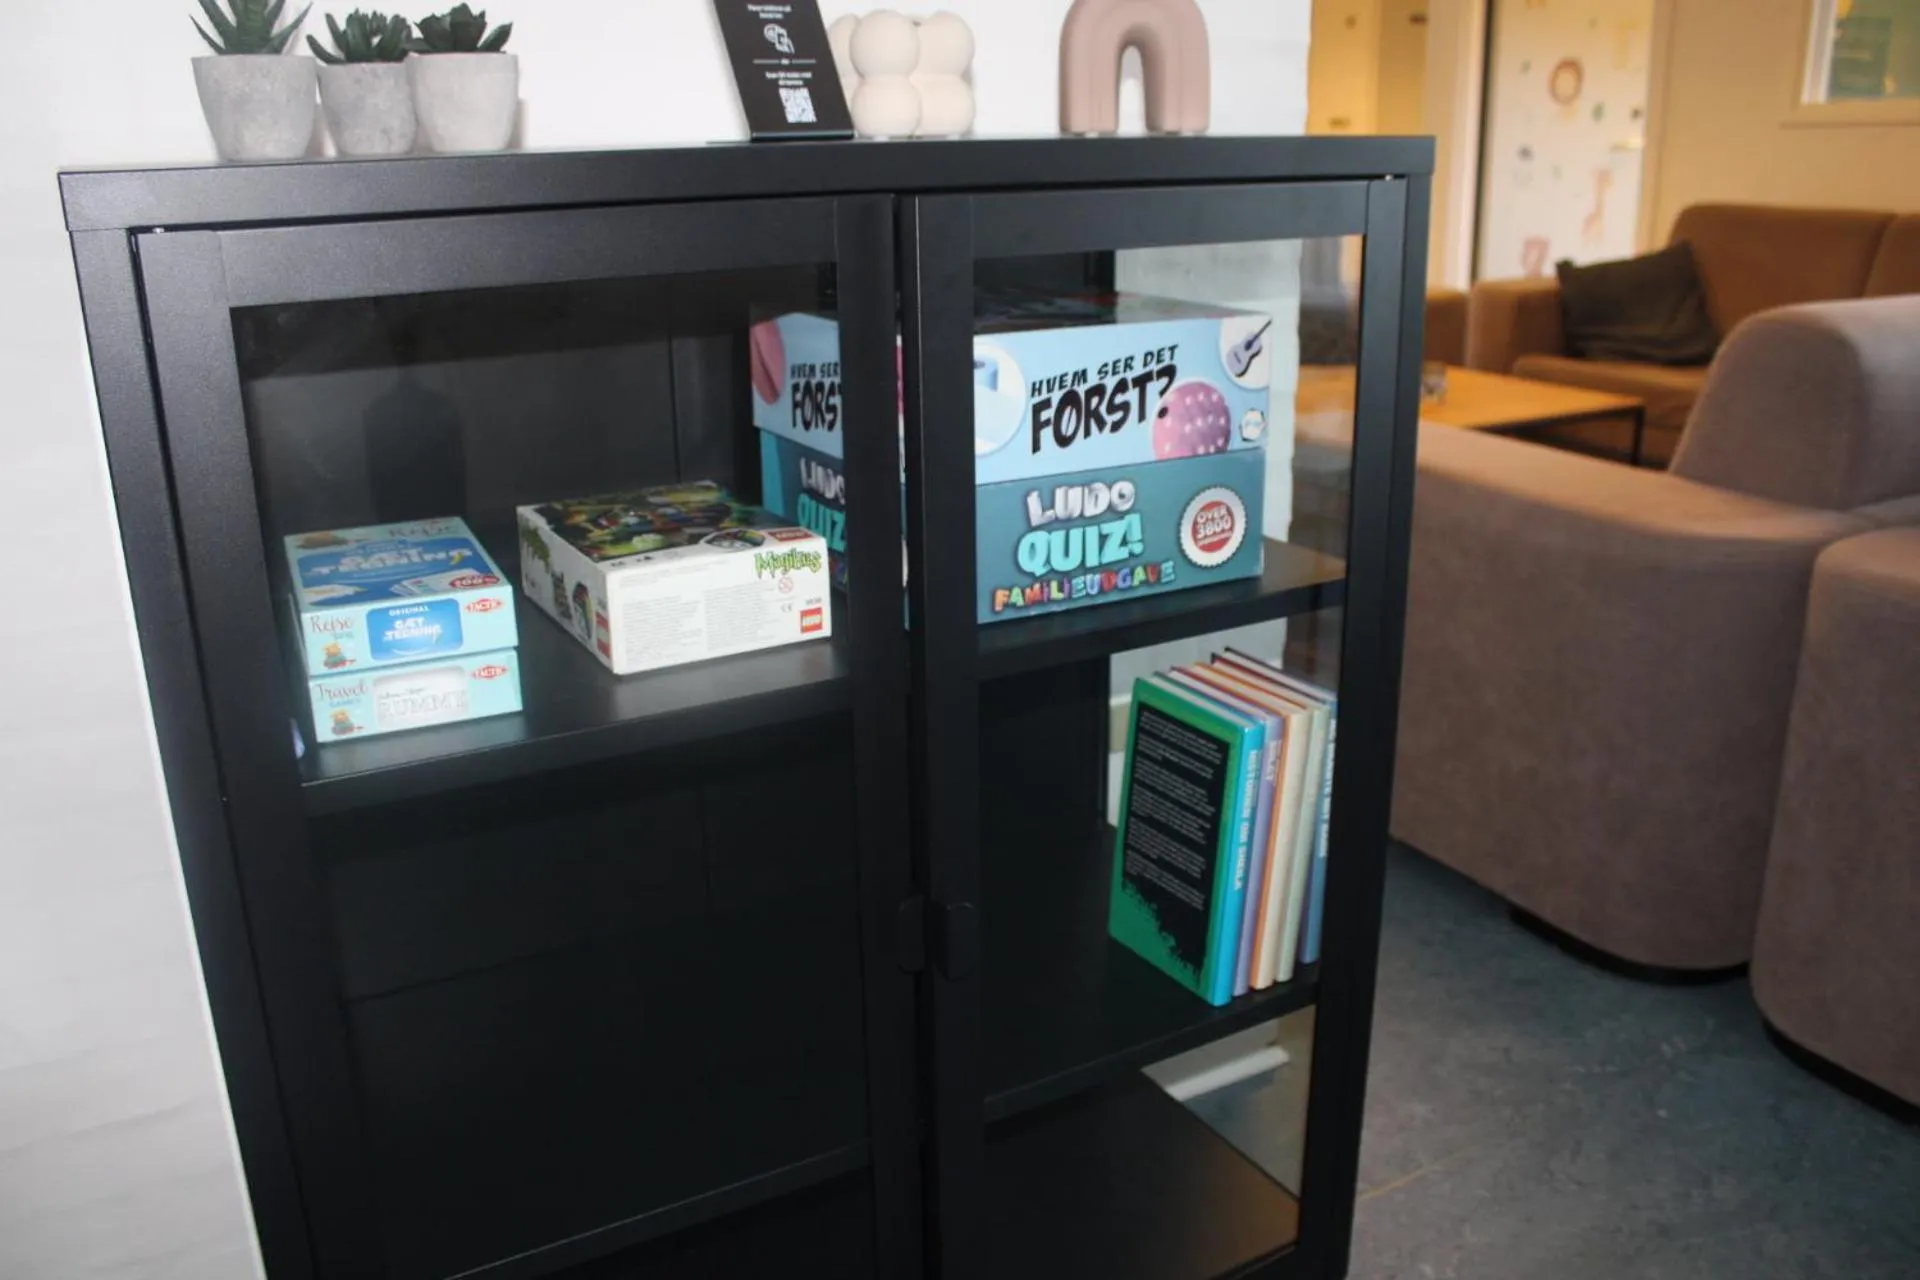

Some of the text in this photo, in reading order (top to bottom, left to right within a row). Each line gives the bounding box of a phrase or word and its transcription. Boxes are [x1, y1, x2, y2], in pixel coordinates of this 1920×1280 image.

[790, 362, 839, 379] HVEM SER
[1031, 344, 1179, 398] HVEM SER DET
[1026, 480, 1136, 527] LUDO
[1197, 504, 1228, 525] OVER
[1017, 512, 1145, 577] QUIZ!
[993, 560, 1176, 613] FAMILIEUDGAVE
